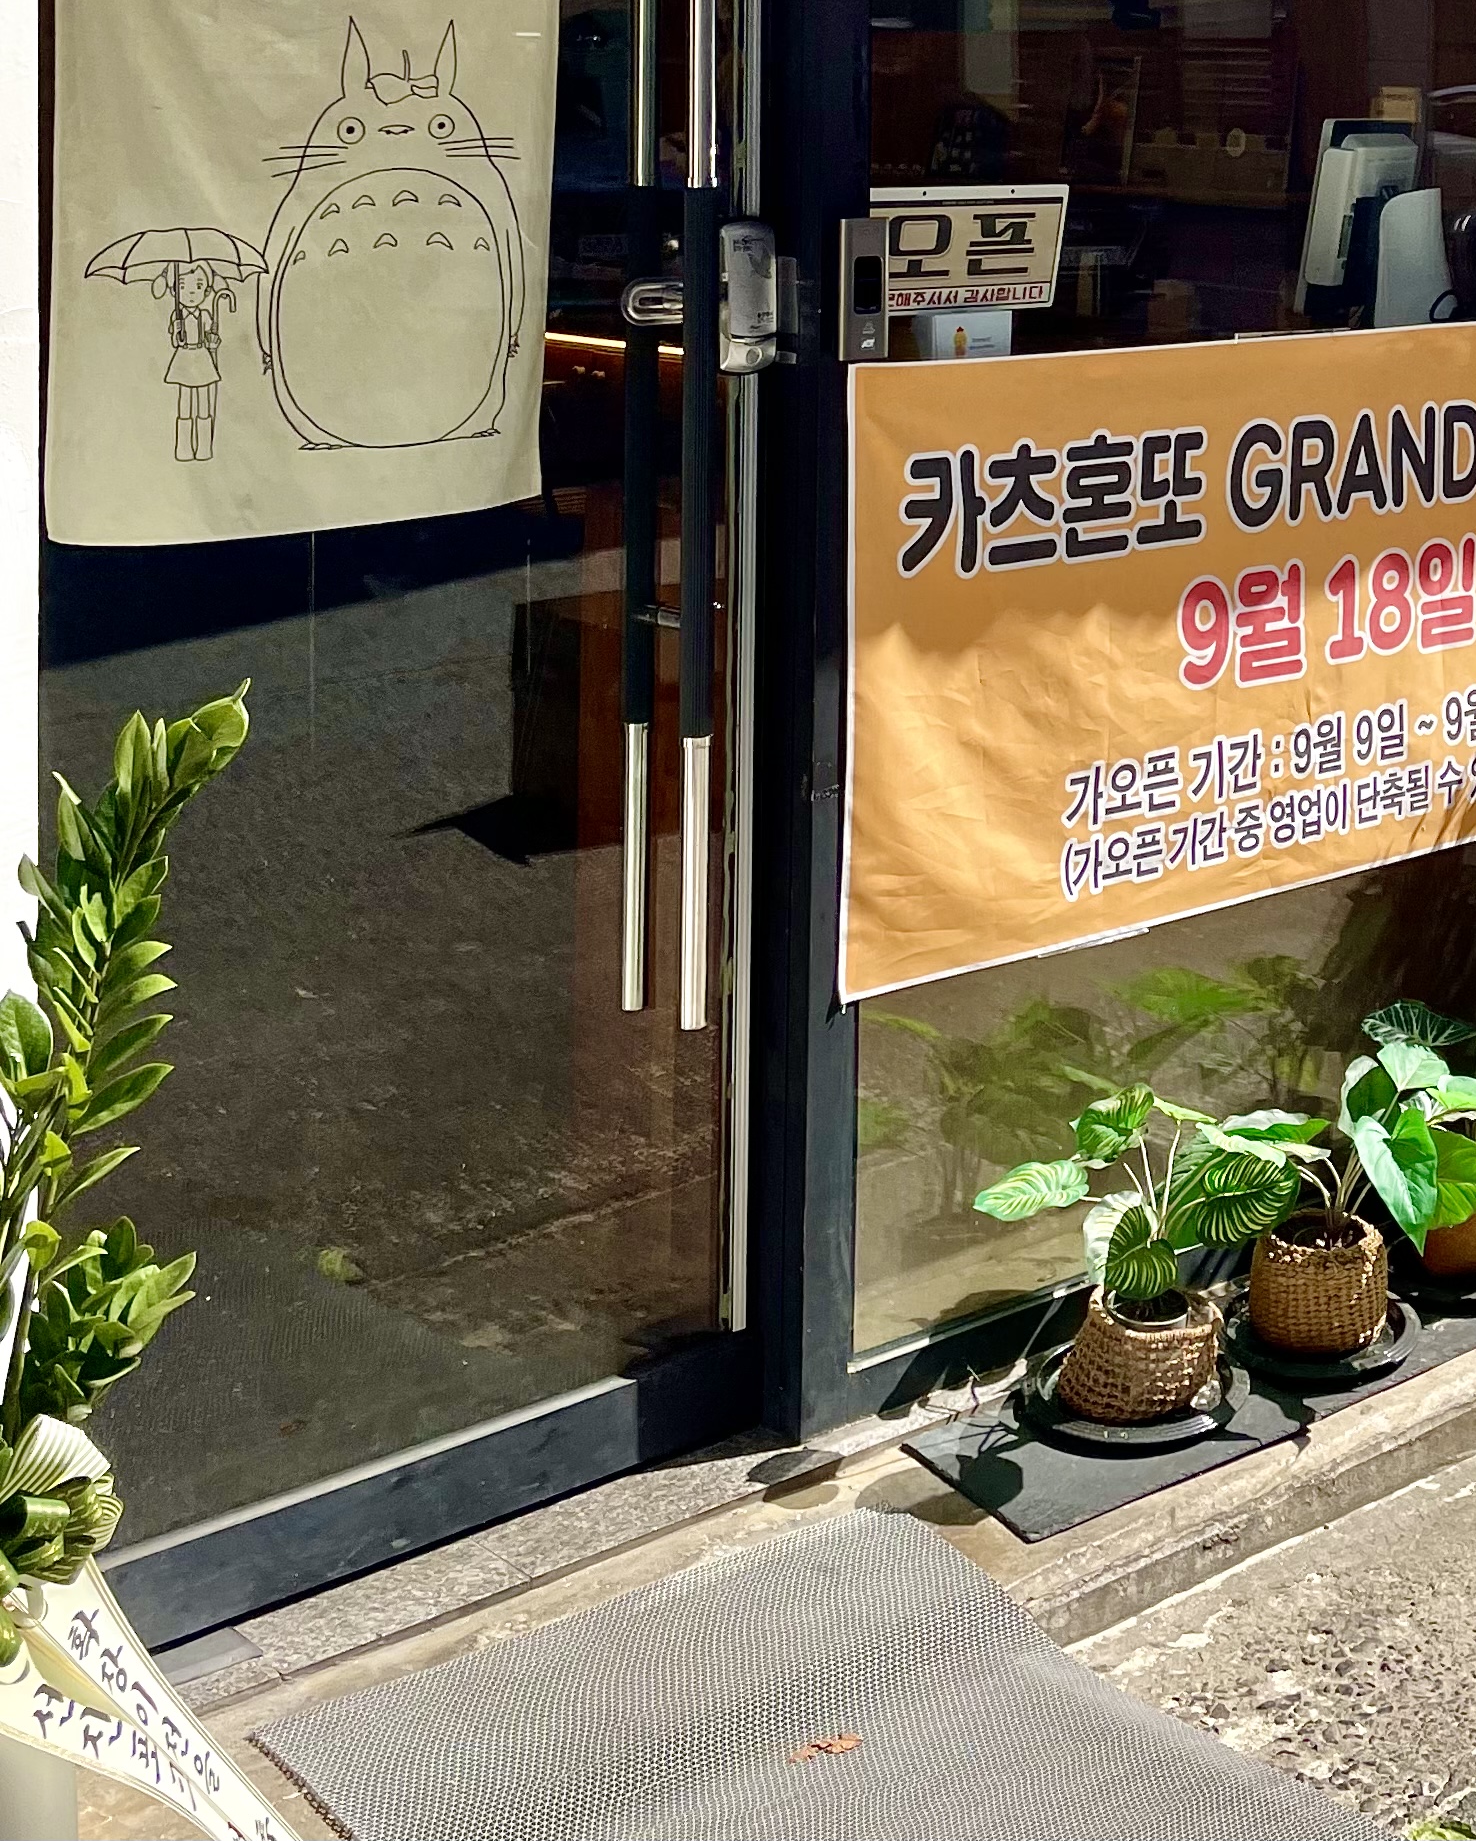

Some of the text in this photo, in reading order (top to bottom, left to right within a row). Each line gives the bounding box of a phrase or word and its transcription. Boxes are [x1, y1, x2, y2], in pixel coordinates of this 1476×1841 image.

[888, 211, 1037, 279] 오픈
[963, 284, 1044, 305] 감사합니다
[901, 433, 1204, 572] 카츠혼또
[1181, 563, 1304, 685] 9월
[1065, 751, 1180, 826] 가오픈
[1190, 733, 1263, 799] 기간
[1293, 715, 1343, 775] 9월
[1355, 703, 1406, 761] 9일
[1064, 827, 1164, 896] (가오픈
[1168, 811, 1228, 866] 기간
[1234, 805, 1264, 853] 중
[1269, 783, 1348, 845] 영업이
[1356, 765, 1430, 825] 단축될
[1436, 760, 1464, 805] 수
